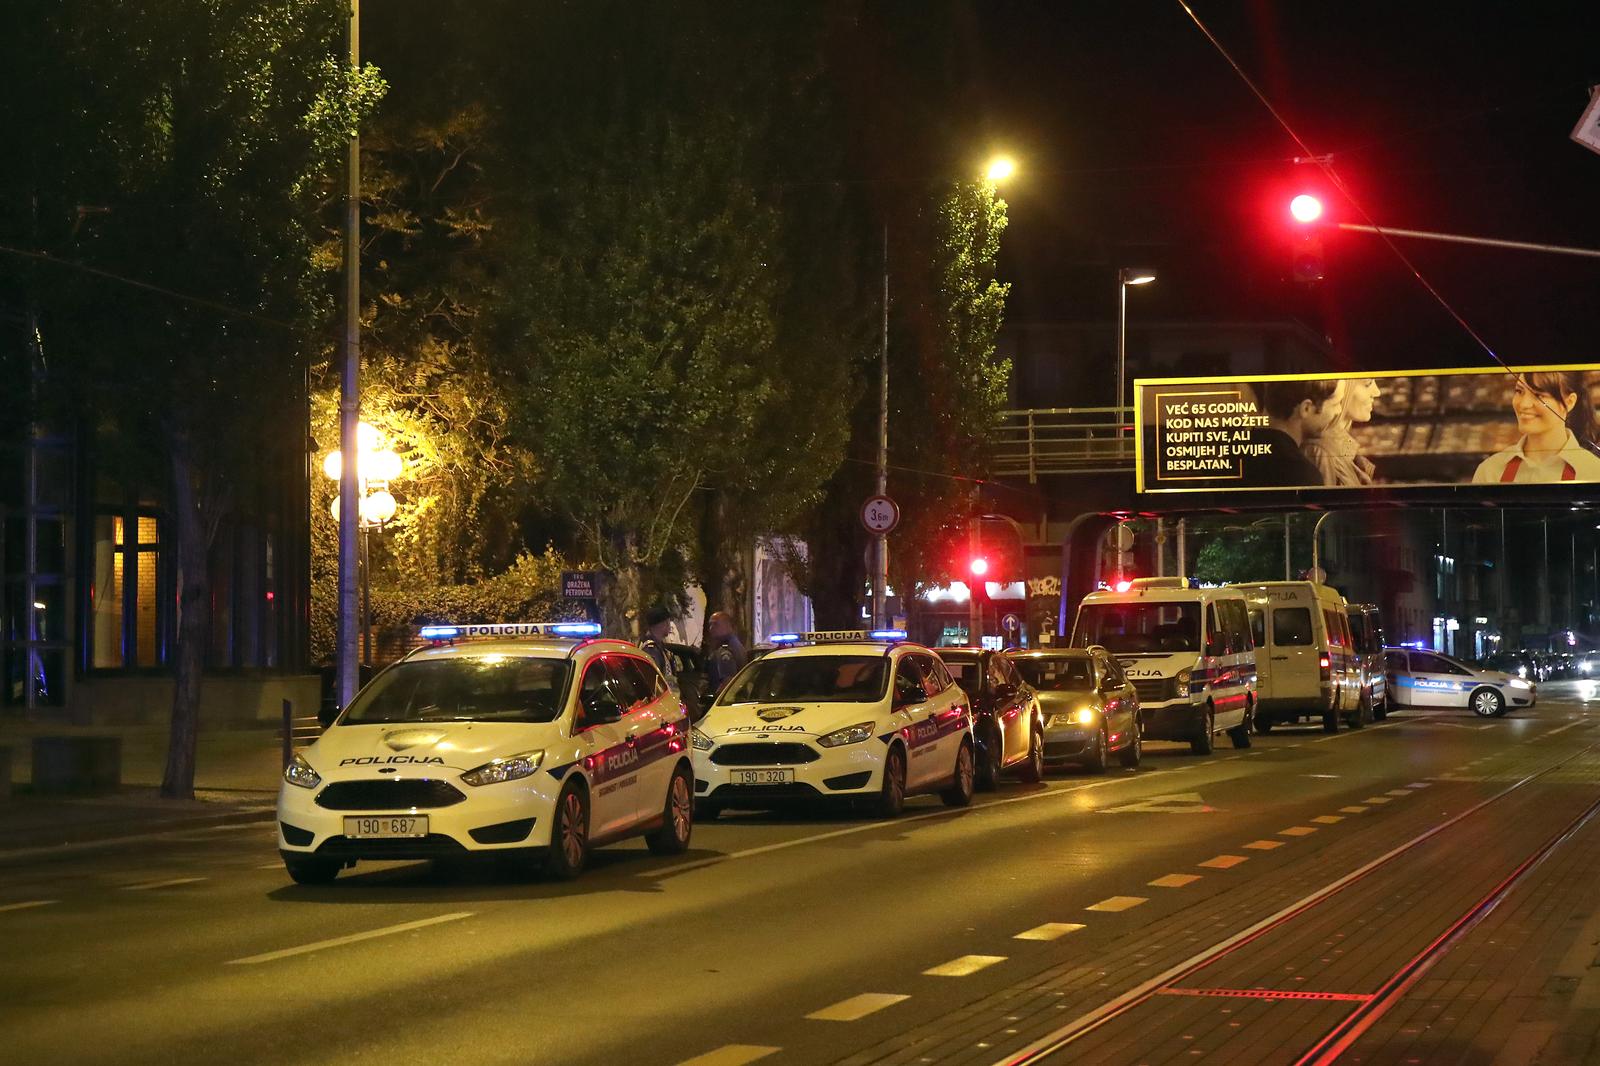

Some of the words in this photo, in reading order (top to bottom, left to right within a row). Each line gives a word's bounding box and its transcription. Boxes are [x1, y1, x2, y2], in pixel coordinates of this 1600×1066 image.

[1165, 402, 1189, 415] VEĆ
[1191, 404, 1206, 414] 65
[1208, 402, 1257, 414] GODINA
[1166, 418, 1192, 429] KOD
[1194, 418, 1219, 428] NAS
[1222, 414, 1270, 427] MOŽETE
[1166, 432, 1204, 443] KUPITI
[1206, 431, 1231, 443] SVE,
[1233, 431, 1250, 441] ALI
[1166, 445, 1215, 458] OSMIJEH
[1218, 445, 1230, 457] JE
[1232, 444, 1272, 456] UVIJEK
[1166, 459, 1233, 471] BESPLATAN.
[469, 625, 541, 635] POLICIJA
[807, 632, 862, 640] POLICIJA
[726, 725, 806, 734] POLICIJA
[339, 755, 445, 767] POLICIJA
[608, 748, 639, 771] POLICIJA
[740, 771, 758, 783] 190
[766, 771, 785, 782] 320
[357, 819, 380, 834] 190
[391, 818, 416, 834] 687
